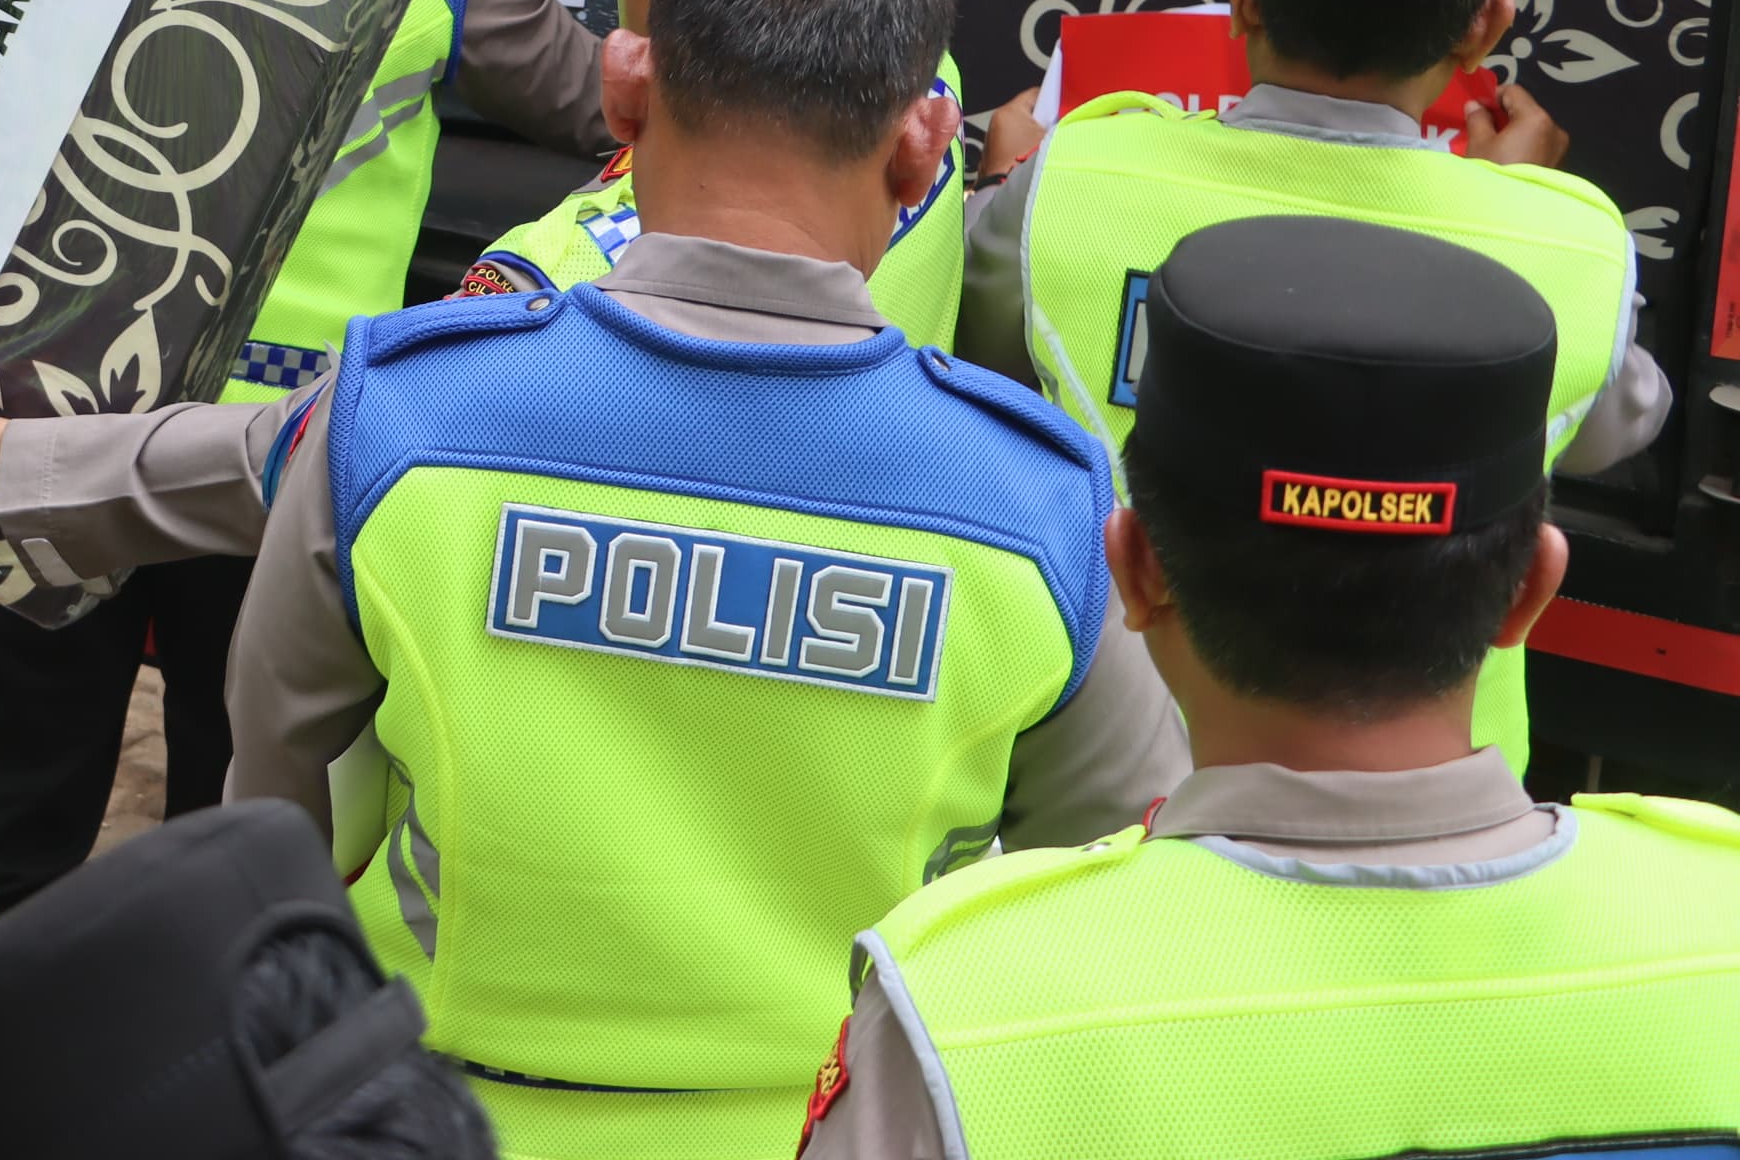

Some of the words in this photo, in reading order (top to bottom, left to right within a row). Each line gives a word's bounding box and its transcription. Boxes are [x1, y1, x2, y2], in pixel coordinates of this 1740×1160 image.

[468, 281, 497, 296] CIL
[1282, 483, 1433, 523] KAPOLSEK
[505, 518, 934, 686] POLISI
